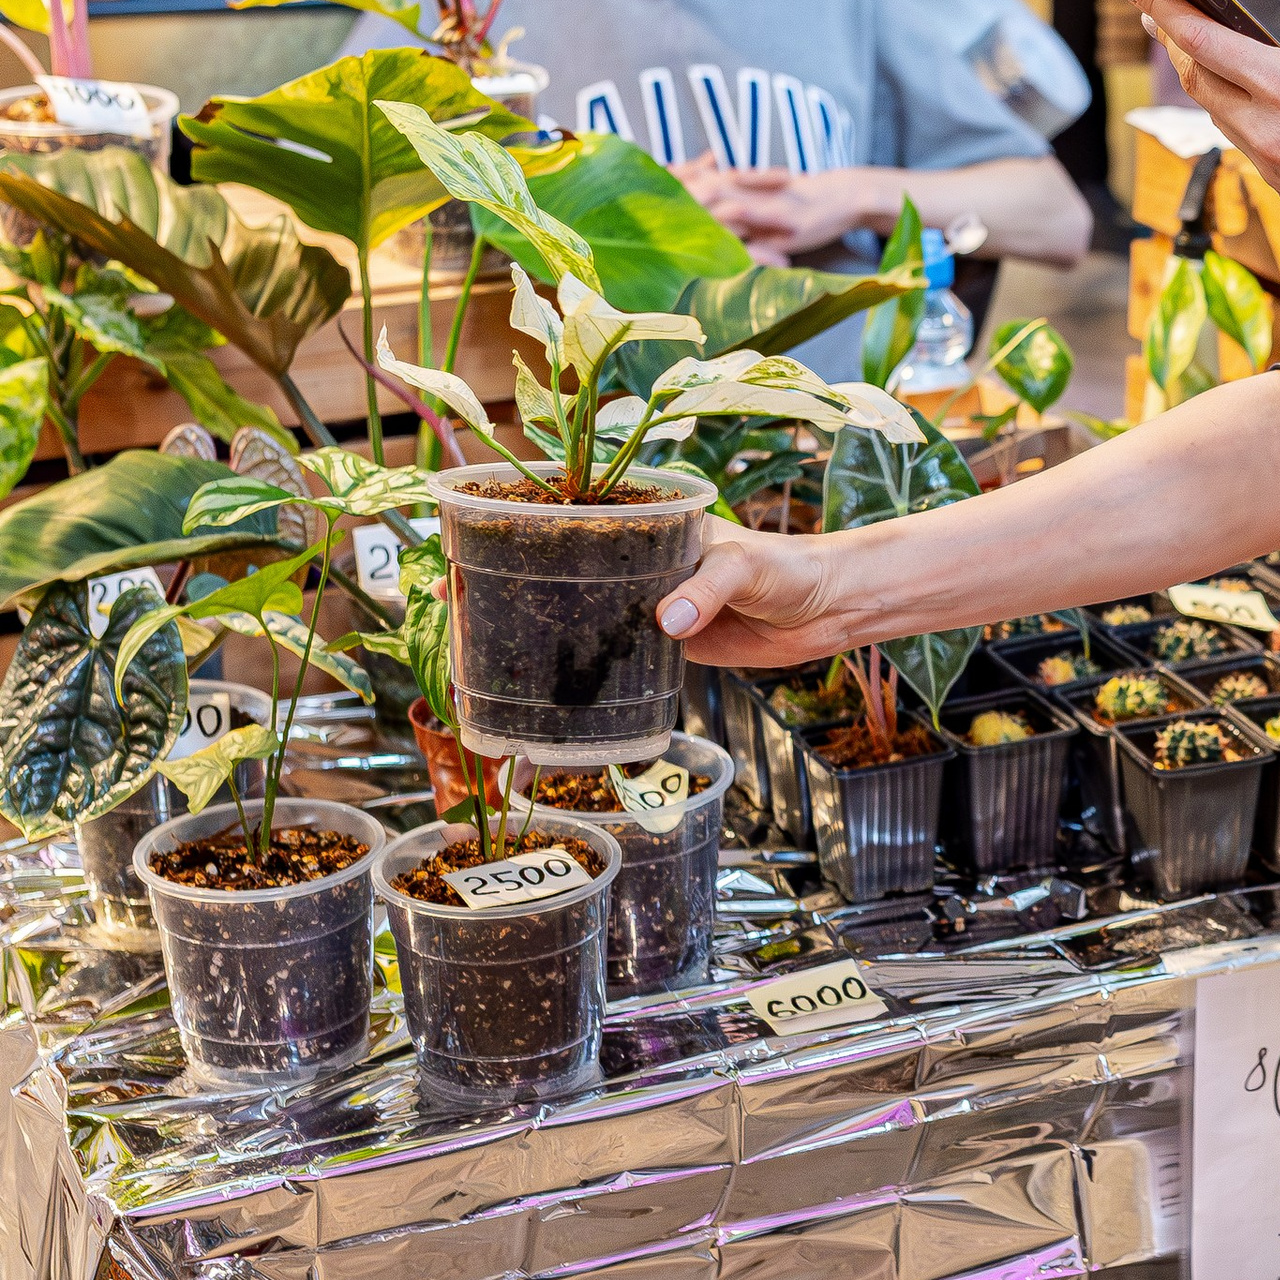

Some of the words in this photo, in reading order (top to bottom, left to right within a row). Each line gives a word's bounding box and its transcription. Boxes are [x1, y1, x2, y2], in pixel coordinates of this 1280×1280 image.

[369, 543, 403, 580] 2
[463, 858, 573, 896] 2500
[766, 976, 868, 1019] 6000
